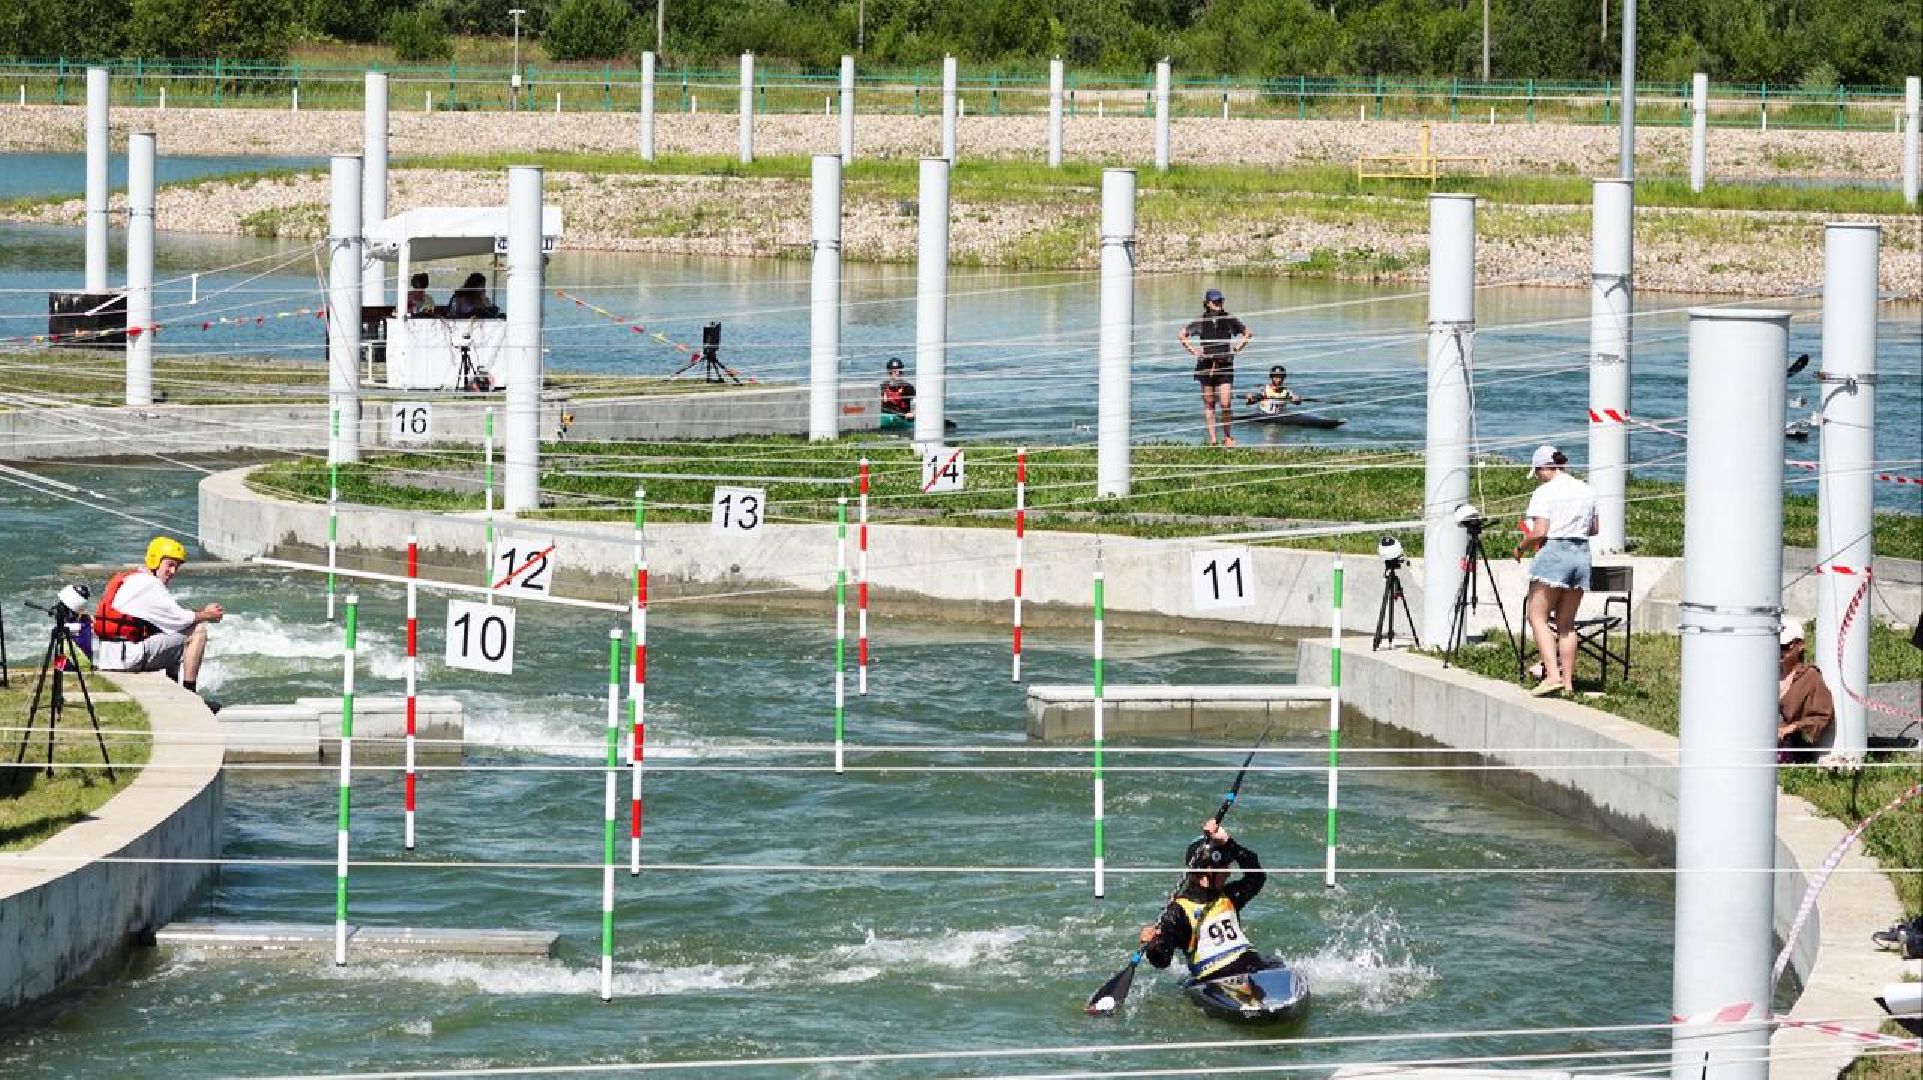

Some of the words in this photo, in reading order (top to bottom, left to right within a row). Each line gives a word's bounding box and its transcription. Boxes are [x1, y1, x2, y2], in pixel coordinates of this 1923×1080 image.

[396, 408, 427, 434] 16
[927, 455, 959, 484] 14
[718, 494, 759, 531] 13
[501, 548, 548, 590] 12
[1203, 557, 1243, 599] 11
[454, 612, 507, 662] 10
[1208, 918, 1238, 947] 95
